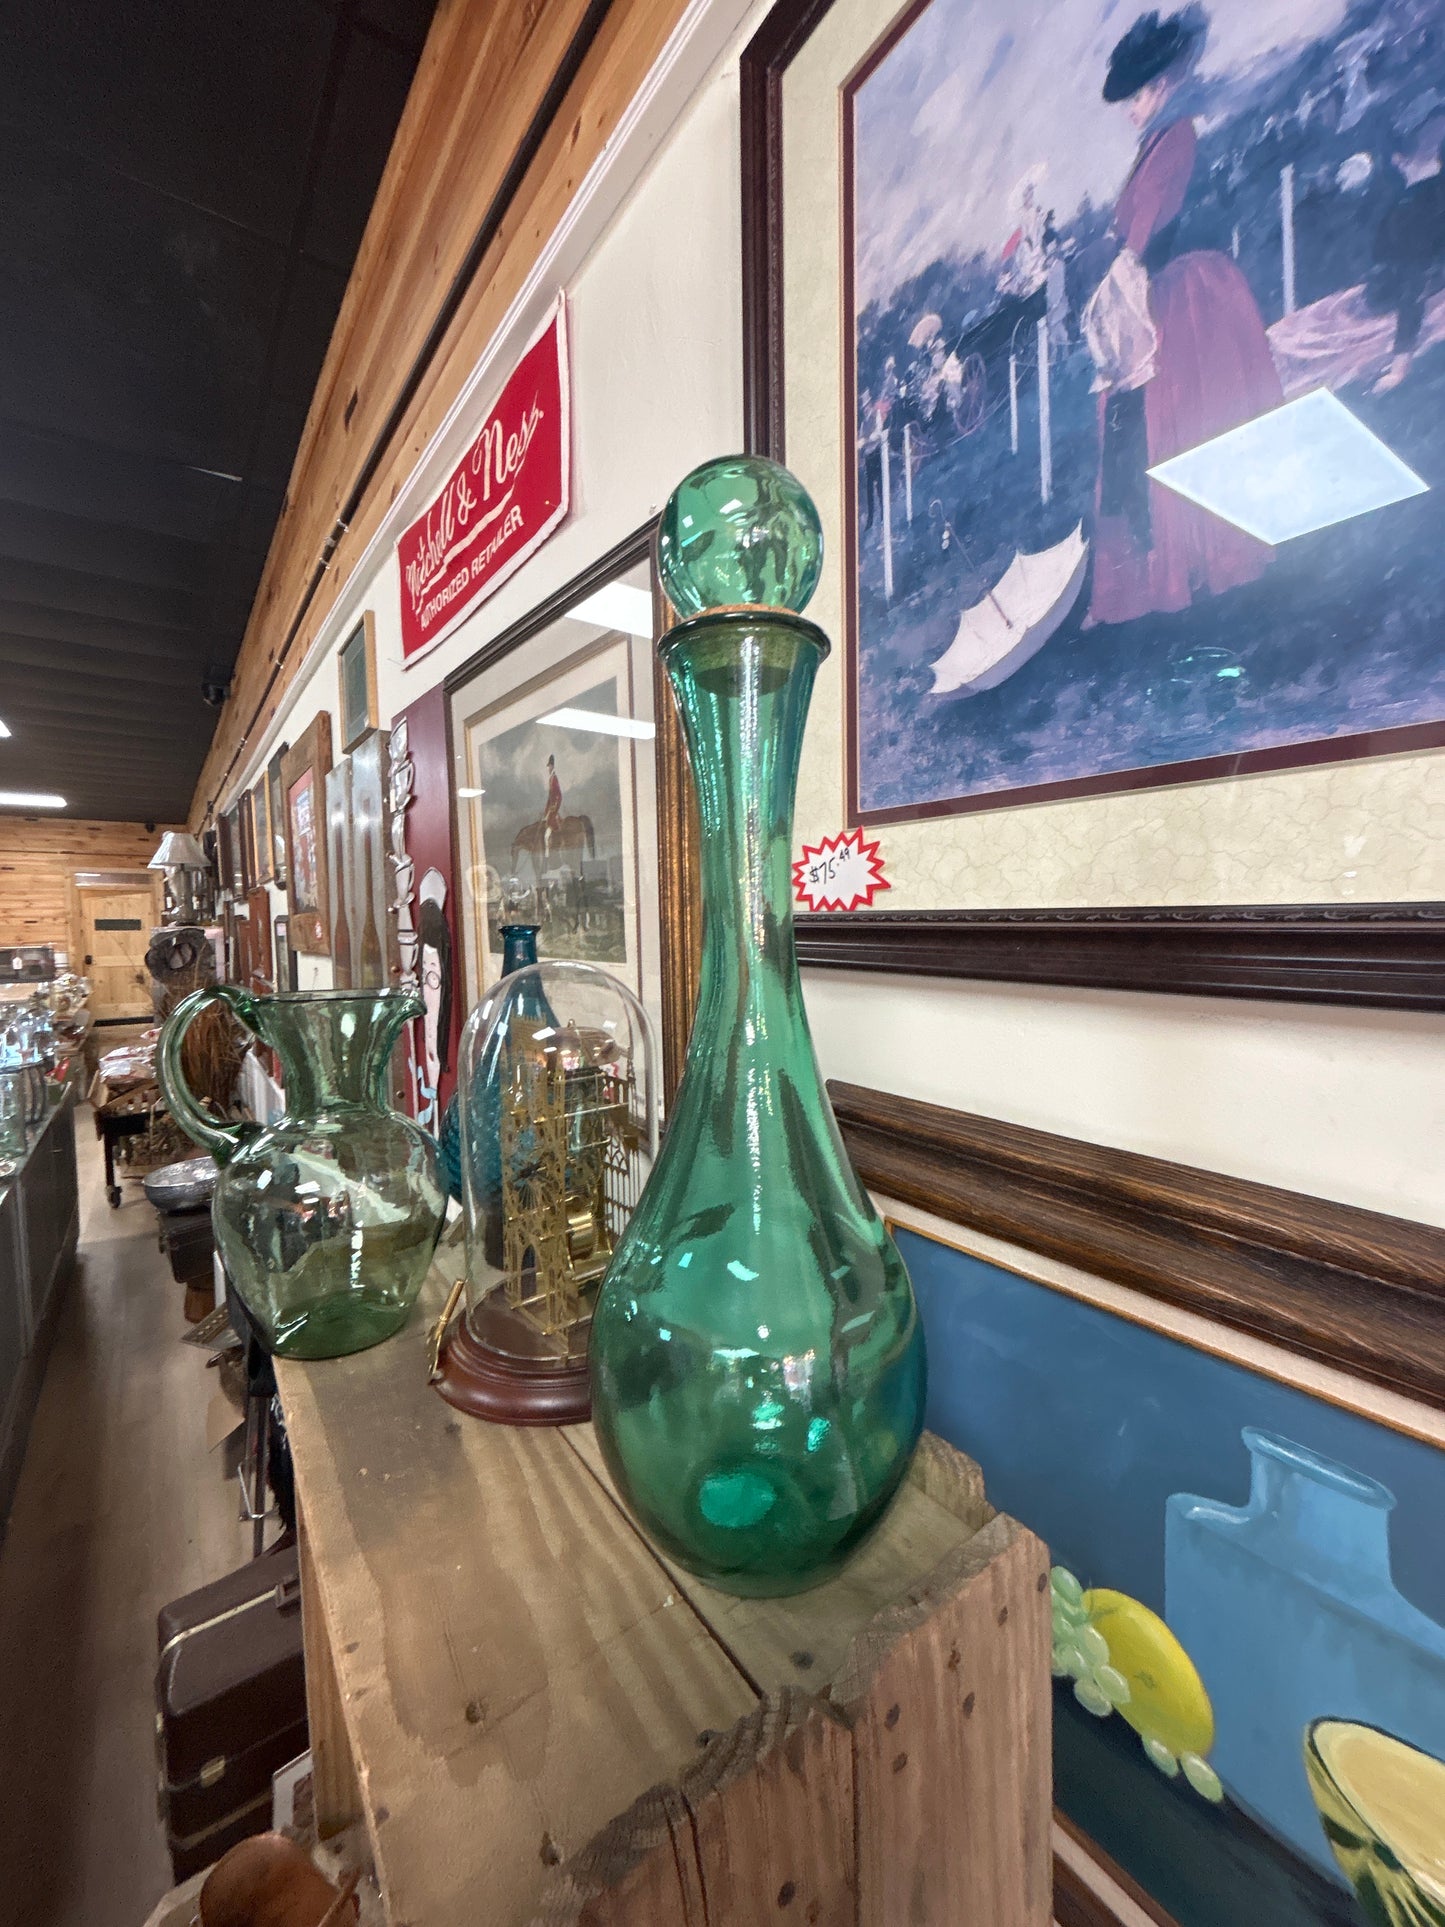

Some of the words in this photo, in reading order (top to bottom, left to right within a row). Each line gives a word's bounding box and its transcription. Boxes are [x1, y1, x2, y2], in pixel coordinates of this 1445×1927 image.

[405, 481, 455, 611] Mitchell
[457, 471, 477, 525] &
[421, 567, 469, 631] AUTHORIZED
